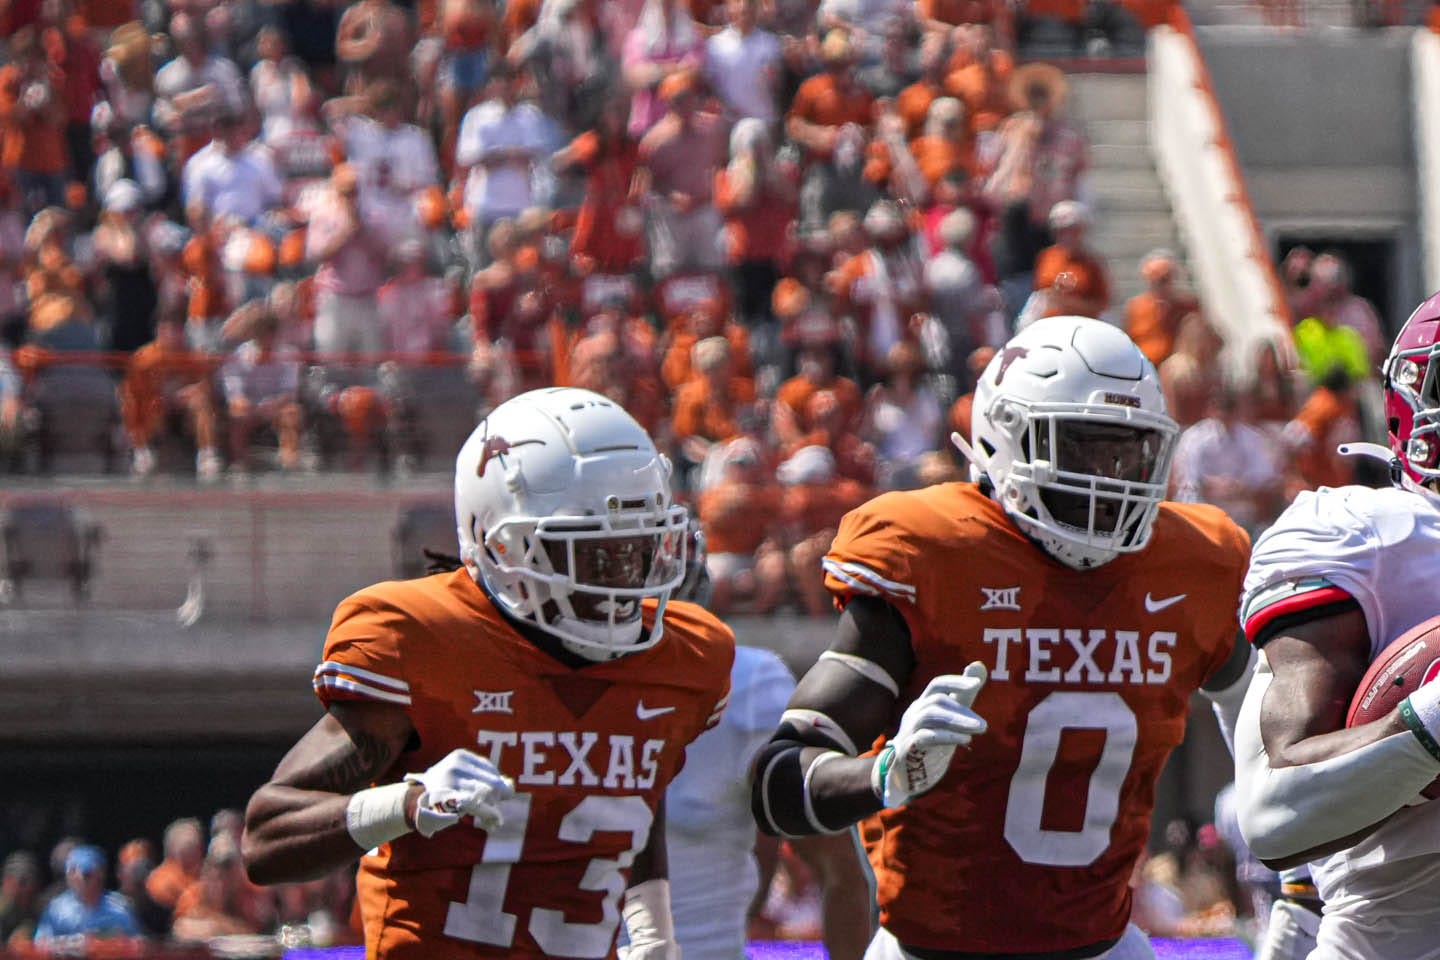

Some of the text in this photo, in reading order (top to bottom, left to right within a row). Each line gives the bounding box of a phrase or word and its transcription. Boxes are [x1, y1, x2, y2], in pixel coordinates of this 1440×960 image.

[982, 628, 1177, 684] TEXAS
[477, 729, 666, 790] TEXAS
[1003, 691, 1138, 867] 0
[442, 792, 655, 960] 13
